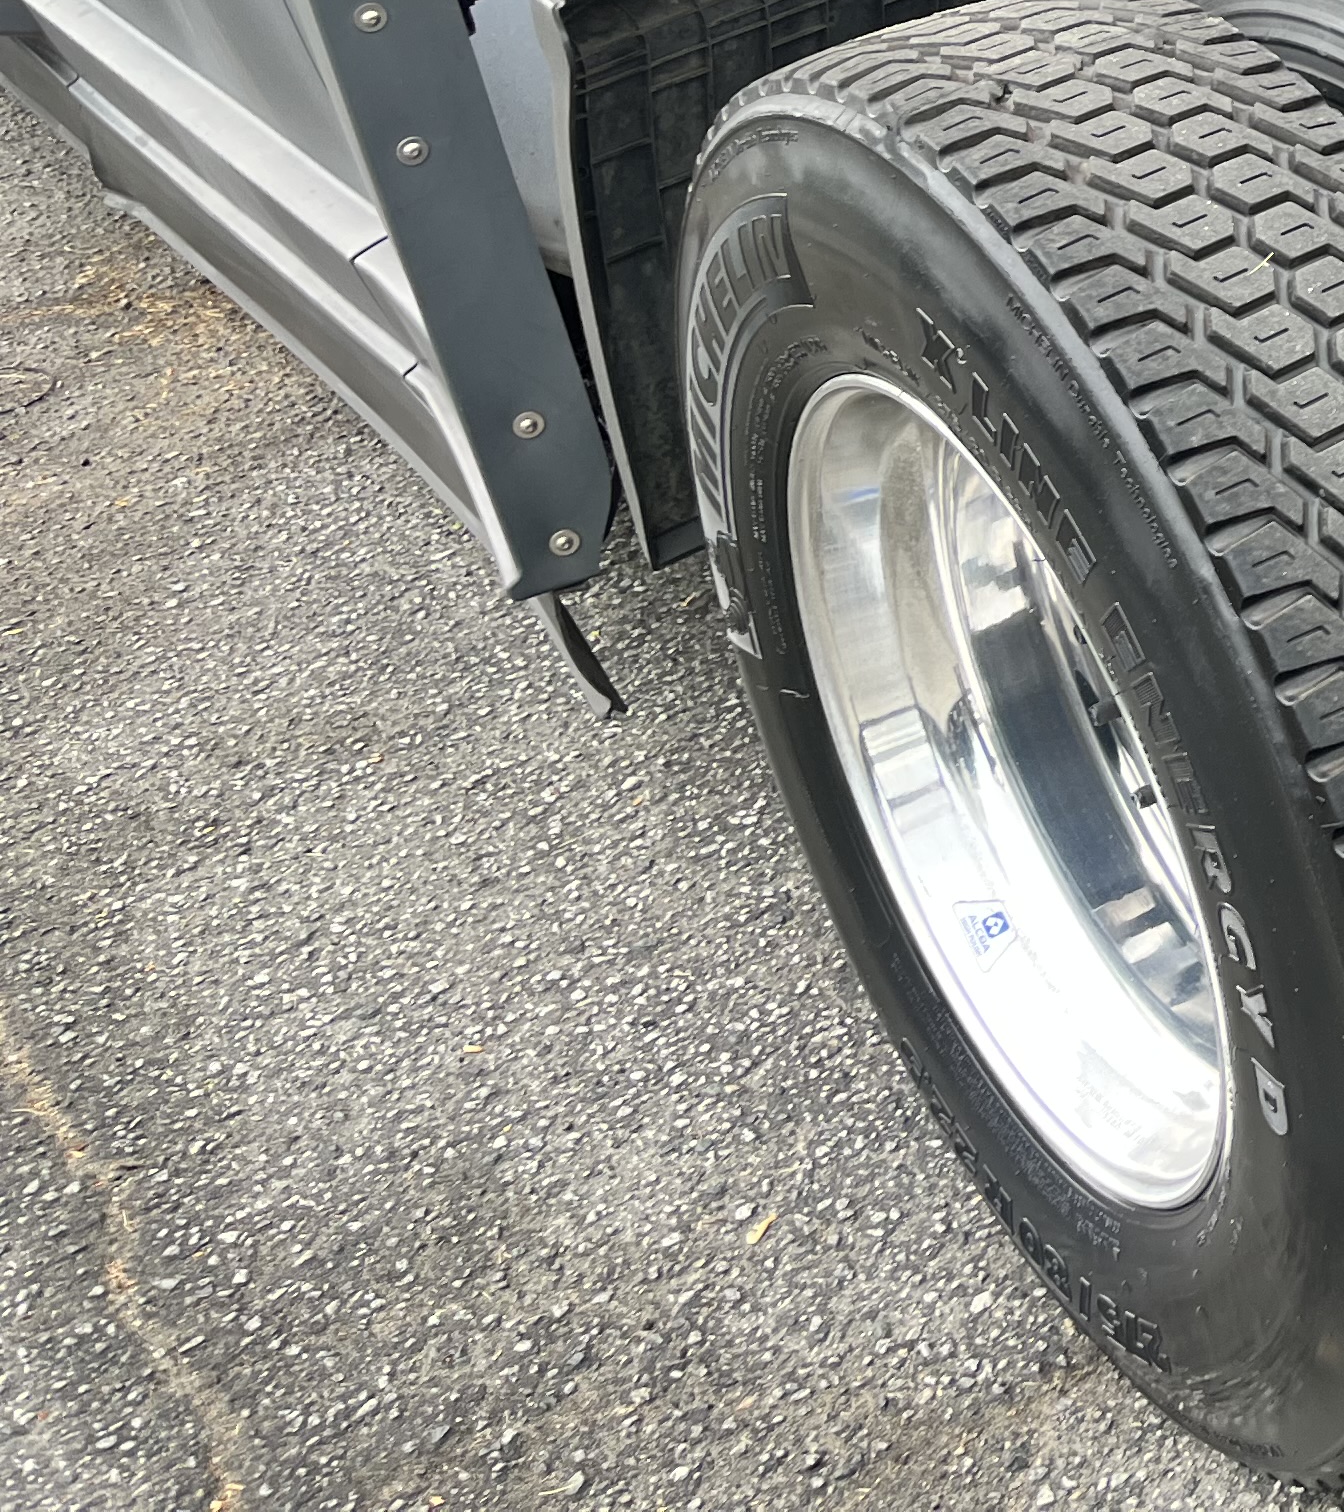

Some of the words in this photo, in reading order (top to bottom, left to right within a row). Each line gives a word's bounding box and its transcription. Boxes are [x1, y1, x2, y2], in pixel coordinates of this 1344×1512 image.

[916, 307, 958, 394] X
[971, 371, 1097, 585] LINE
[1100, 600, 1276, 1050] ENERGY
[1250, 1056, 1289, 1136] D
[967, 915, 991, 954] ALCOA
